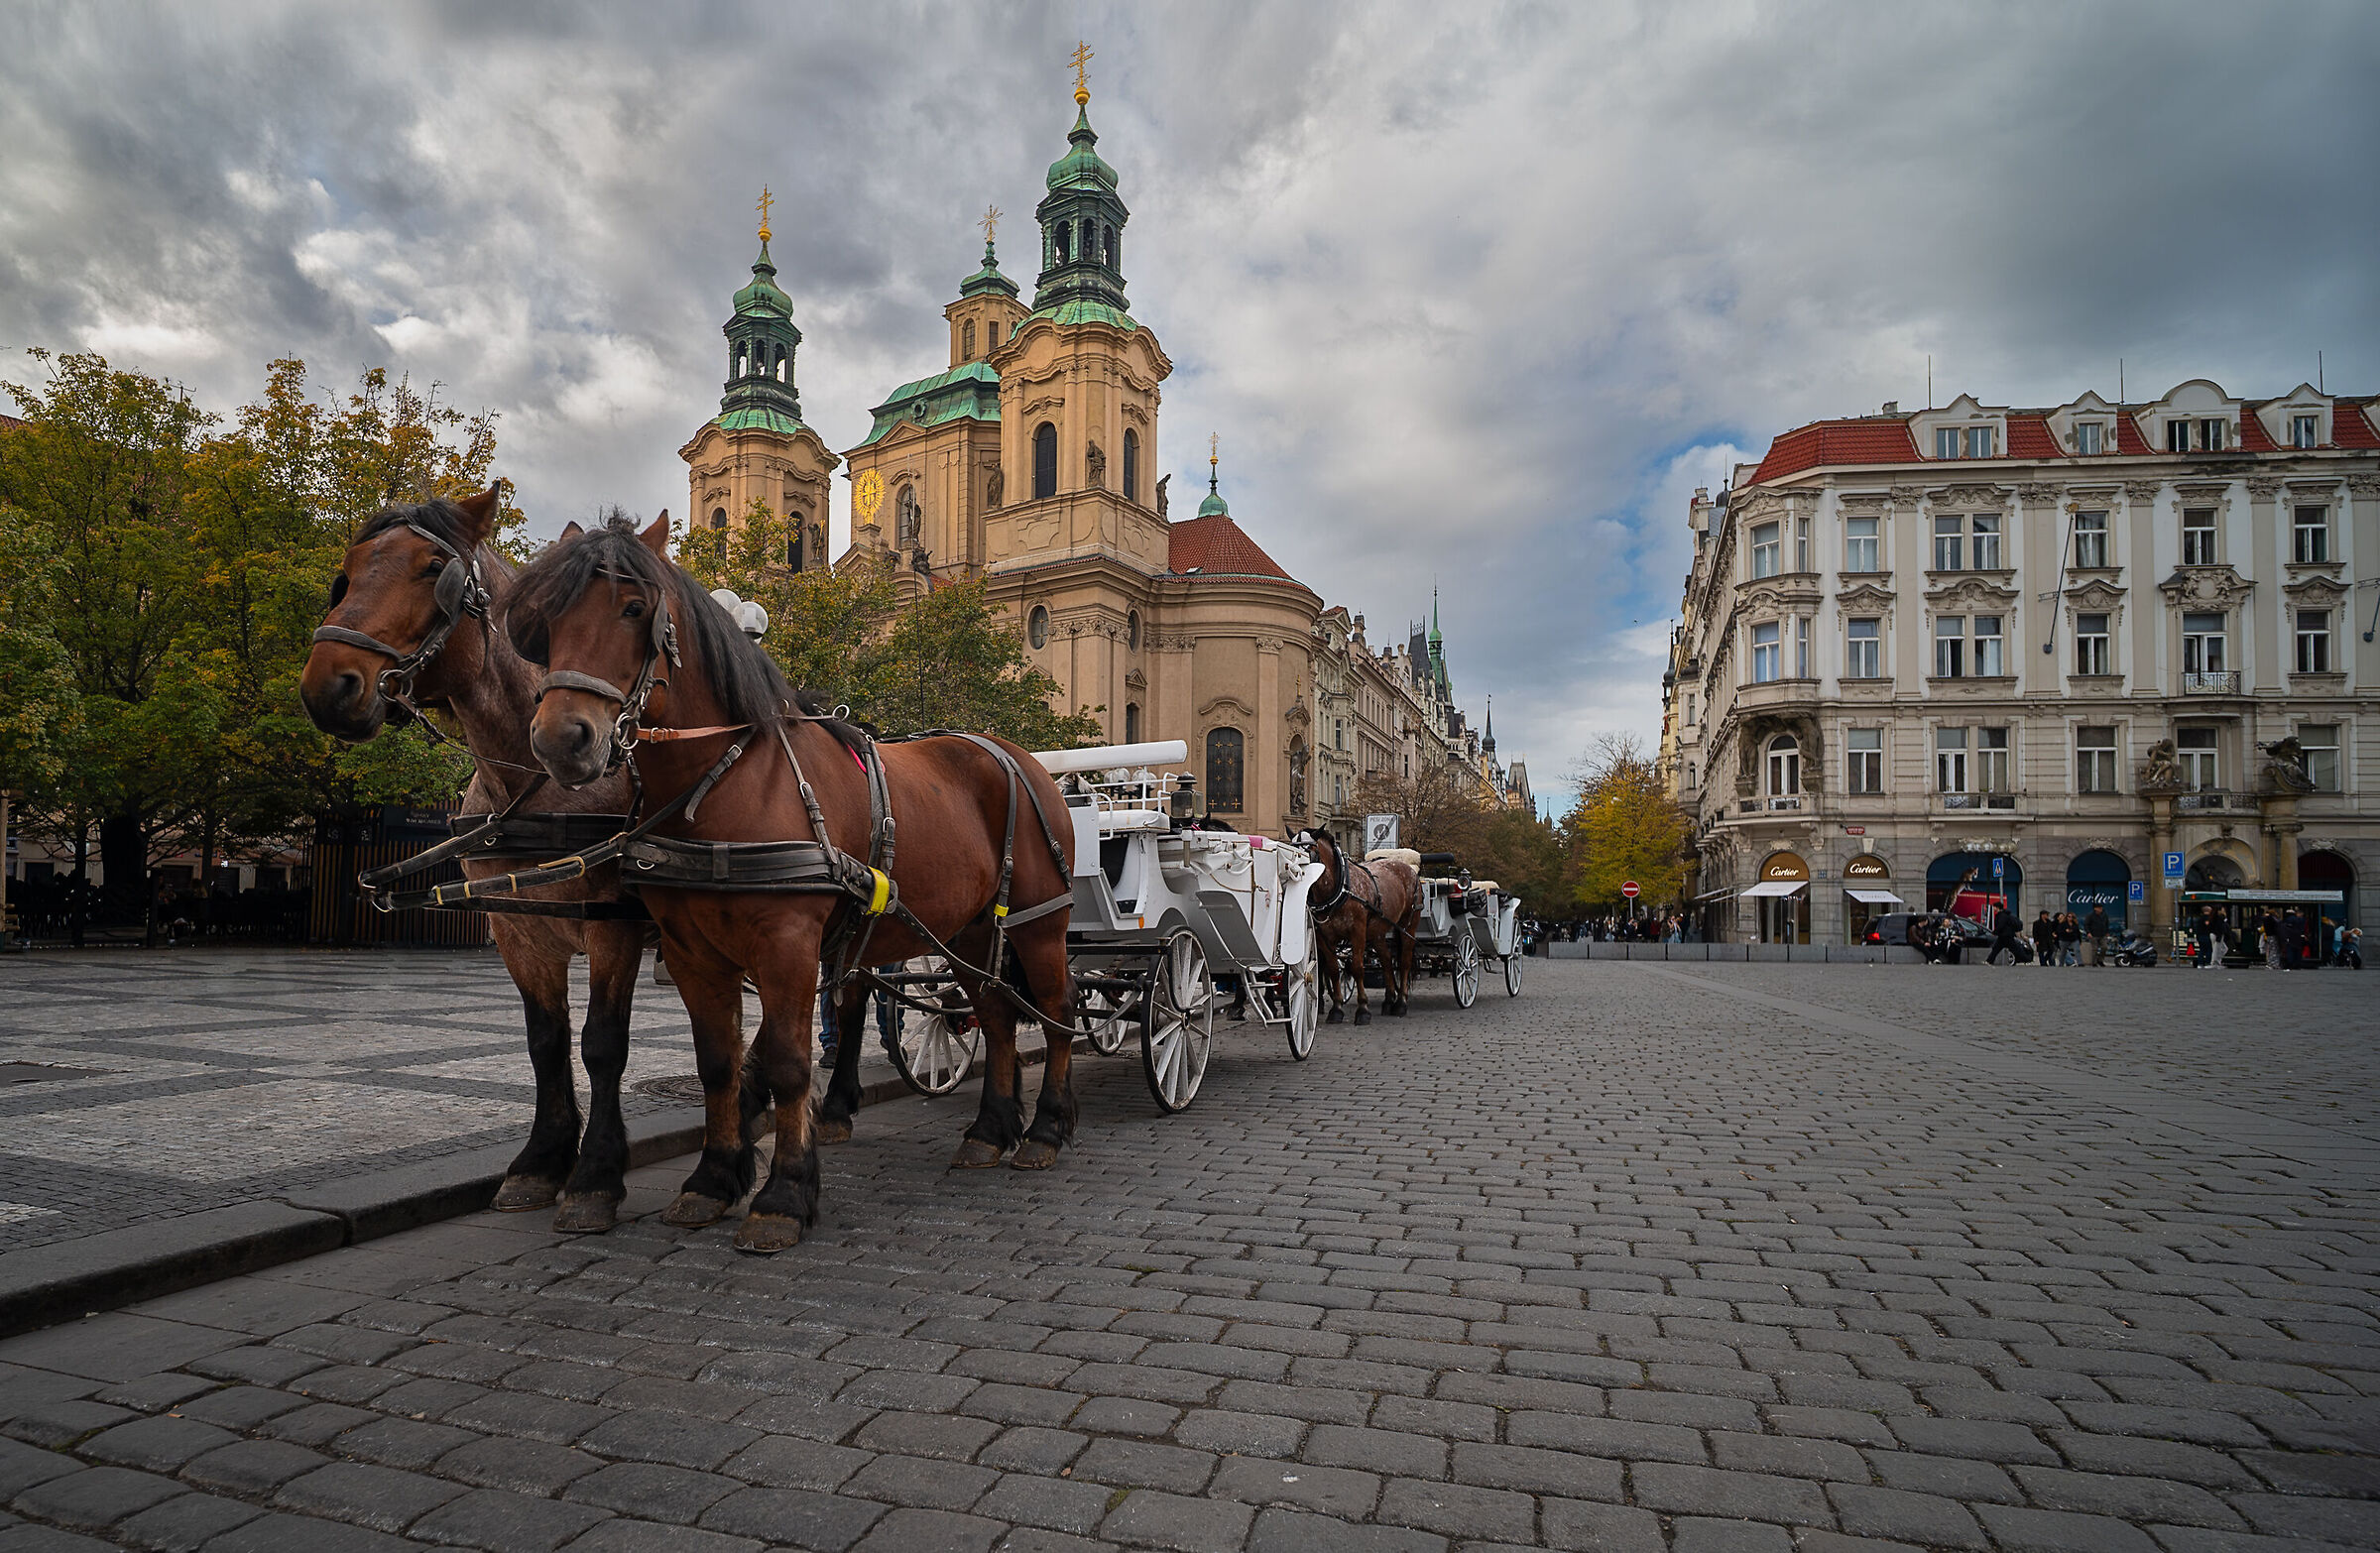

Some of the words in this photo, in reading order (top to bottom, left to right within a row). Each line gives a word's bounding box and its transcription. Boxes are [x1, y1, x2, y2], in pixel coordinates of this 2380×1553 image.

[2168, 855, 2180, 870] P
[1770, 866, 1799, 877] Cartier
[1849, 863, 1882, 875] Cartier
[2131, 884, 2140, 895] P
[2068, 889, 2118, 903] Cartier
